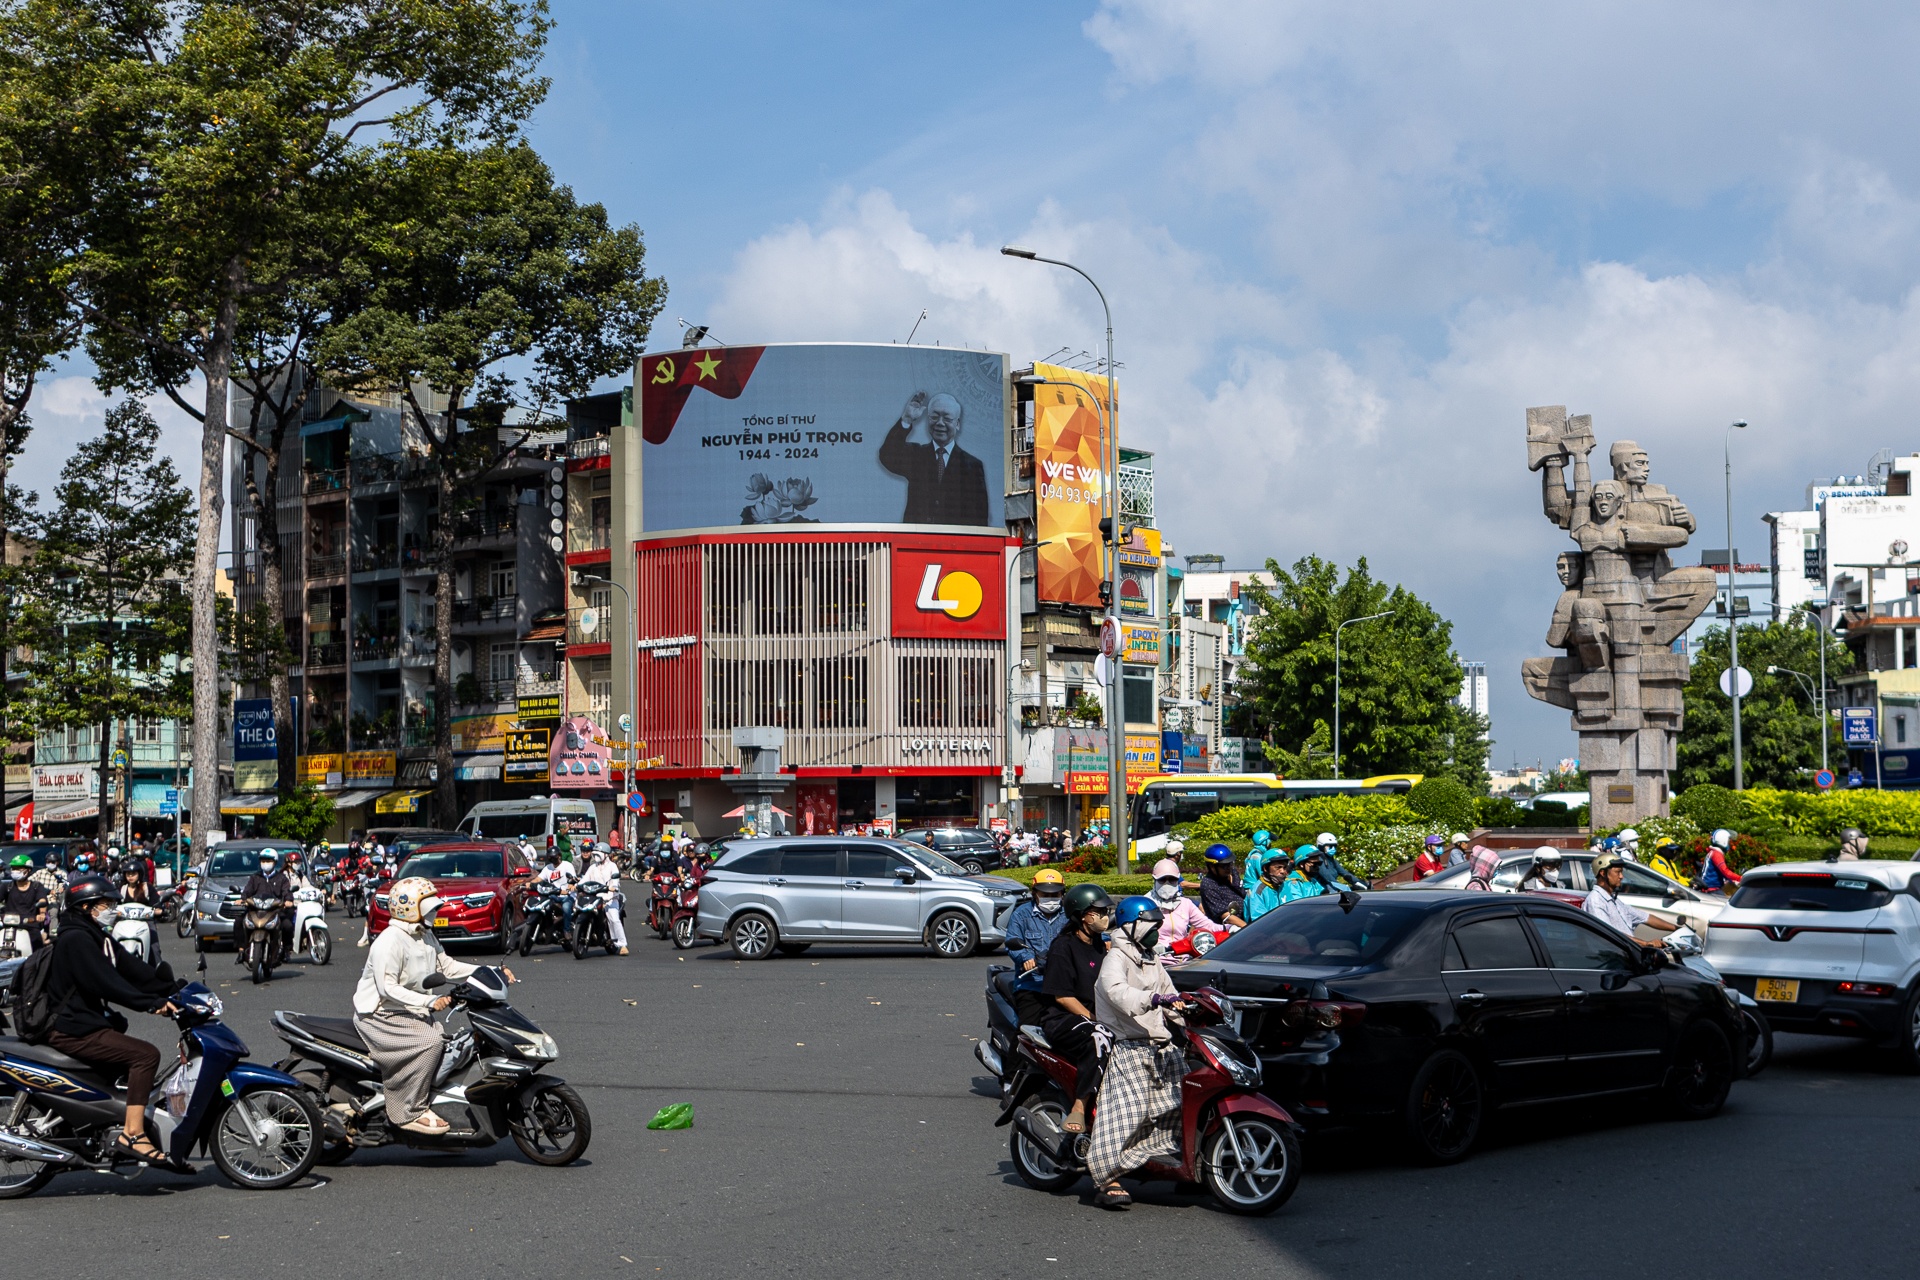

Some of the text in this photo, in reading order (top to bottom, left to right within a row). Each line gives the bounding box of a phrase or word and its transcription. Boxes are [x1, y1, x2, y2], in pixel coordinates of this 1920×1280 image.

[742, 414, 816, 426] TỔNG BÍ THƯ
[701, 428, 863, 448] NGUYỄN PHÚ TRỌNG
[738, 449, 771, 460] 1944
[784, 448, 819, 459] 2024
[1042, 460, 1074, 481] WE
[1041, 483, 1063, 500] 094
[1066, 487, 1080, 503] 93
[1084, 490, 1098, 506] 94
[1132, 629, 1159, 641] EPOXY
[1132, 640, 1159, 652] INTER
[256, 708, 270, 721] NỘI
[239, 728, 263, 742] THE
[902, 740, 991, 751] LOTTERIA
[1074, 774, 1090, 783] LÀM
[1091, 774, 1105, 783] TỐT
[1768, 980, 1787, 990] 50H
[1760, 990, 1793, 1000] 472.93
[1185, 1080, 1202, 1088] HONDA
